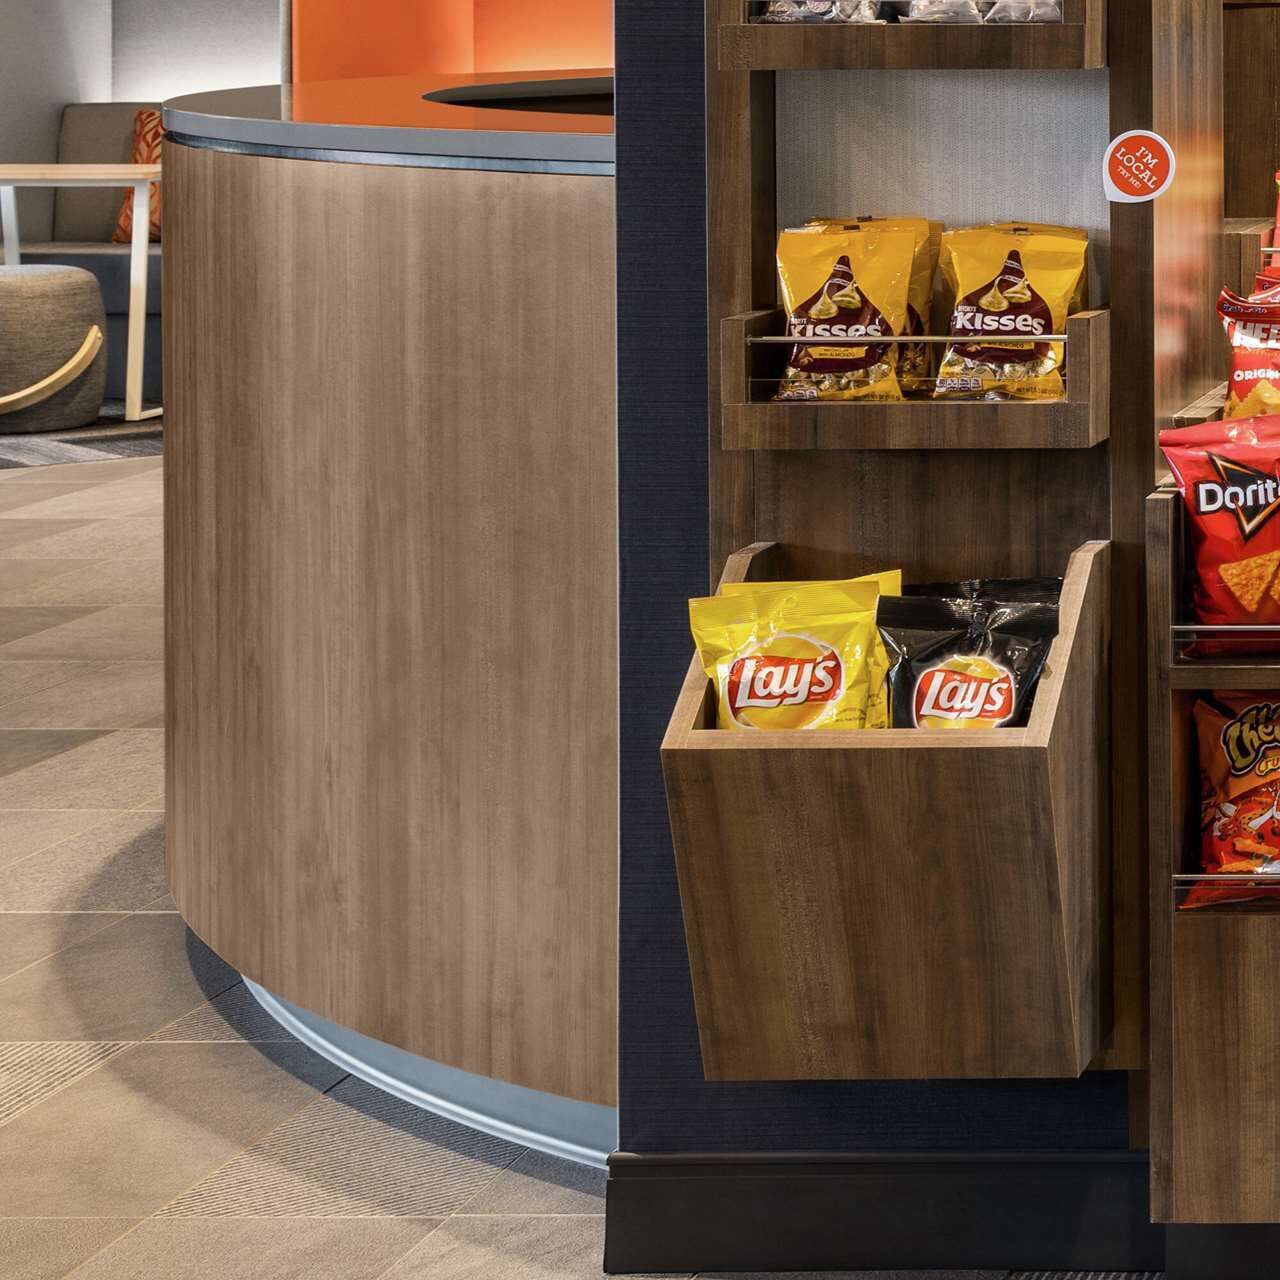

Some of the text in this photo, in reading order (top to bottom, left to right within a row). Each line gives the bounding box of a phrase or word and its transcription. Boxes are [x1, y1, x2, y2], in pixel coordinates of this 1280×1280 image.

[1115, 147, 1158, 189] LOCAL
[1135, 146, 1159, 169] I'M
[735, 652, 836, 709] Lay's
[919, 670, 1011, 719] Lay's
